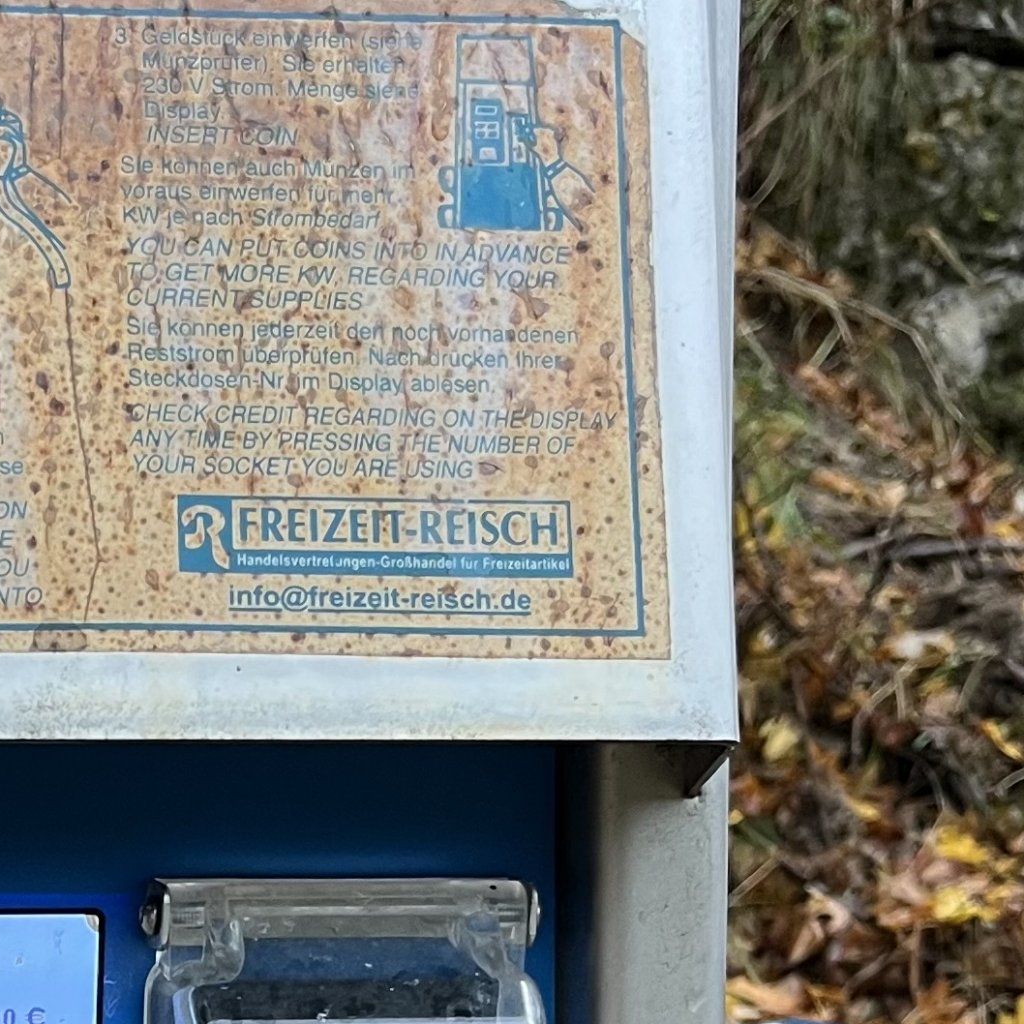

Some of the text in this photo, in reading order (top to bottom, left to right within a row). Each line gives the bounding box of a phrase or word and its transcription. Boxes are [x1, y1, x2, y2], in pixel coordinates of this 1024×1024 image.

[283, 54, 314, 72] Sie
[143, 77, 181, 94] 230
[191, 77, 204, 94] V
[288, 80, 357, 102] Menge
[148, 126, 297, 146] INSERT COIN
[121, 156, 153, 174] Sie
[246, 159, 296, 176] auch
[121, 186, 191, 200] voraus
[200, 184, 299, 201] einwerfen
[123, 206, 159, 224] KW
[166, 208, 185, 229] je
[192, 209, 242, 226] nach
[126, 237, 570, 264] YOU CAN PUT COINS INTO IN ADVANCE
[127, 262, 157, 281] TO
[165, 263, 214, 281] GET
[219, 264, 290, 283] MORE
[347, 266, 486, 287] REGARDING
[492, 269, 558, 288] YOUR
[127, 288, 364, 310] CURRENT SUPPLIES
[127, 317, 159, 335] Sie
[251, 321, 340, 341] jederzeit
[392, 323, 439, 341] noch
[449, 324, 579, 344] vorhandenen
[127, 344, 234, 362] Reststrom
[369, 349, 422, 366] Nach
[295, 372, 320, 389] im
[328, 373, 402, 395] Display
[131, 403, 617, 429] CHECK CREDIT REGARDING ON THE DISPLAY
[130, 430, 576, 454] ANY TIME BY PRESSING THE NUMBER OF
[133, 454, 474, 479] YOUR SOCKET YOU ARE USING
[238, 506, 559, 546] FREIZEIT-REISCH
[229, 585, 531, 610] info@freizeit-reisch.de
